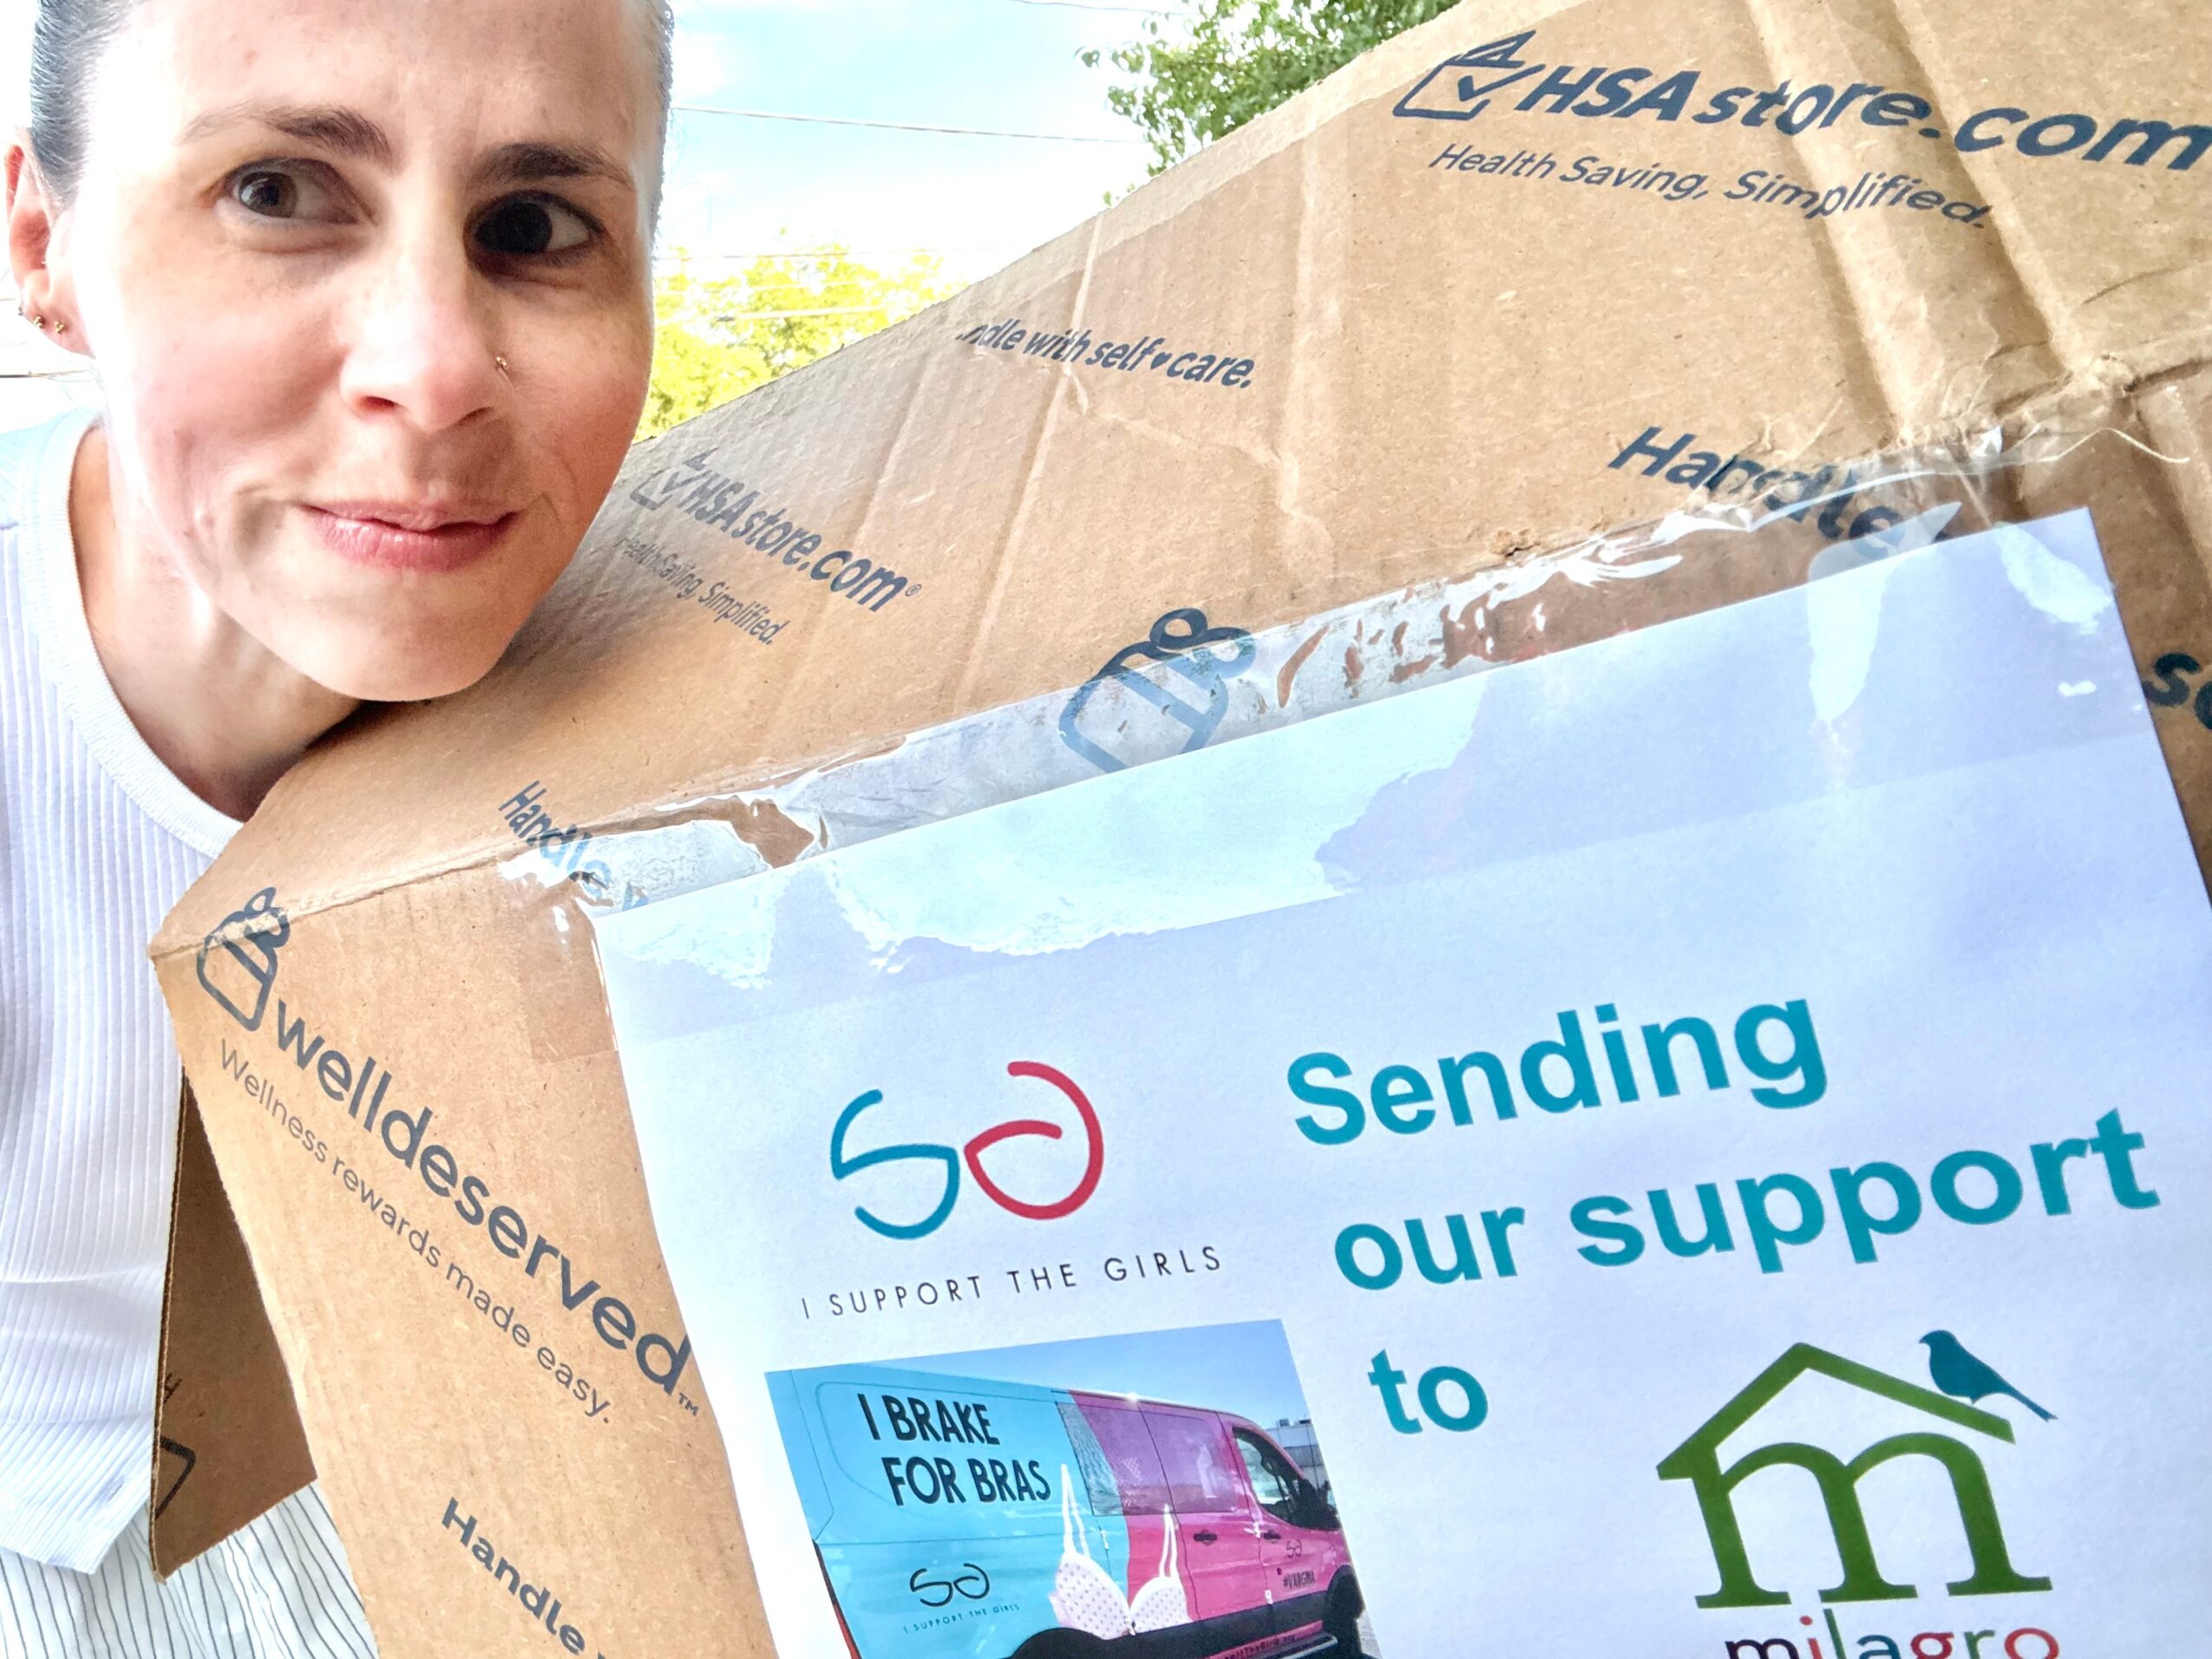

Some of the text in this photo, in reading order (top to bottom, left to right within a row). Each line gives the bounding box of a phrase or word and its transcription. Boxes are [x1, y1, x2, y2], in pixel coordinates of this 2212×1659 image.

[1429, 143, 1993, 230] Health Saving, Simplified.
[1022, 328, 1093, 362] with
[697, 581, 791, 645] Simplified.
[1286, 998, 1829, 1147] Sending
[221, 1038, 610, 1423] Wellness rewards made easy.
[1333, 1107, 2162, 1290] our support
[802, 1245, 1222, 1320] I SUPPORT THE GIRLS
[857, 1393, 1001, 1446] I BRAKE
[1366, 1348, 1489, 1435] to
[881, 1456, 1051, 1506] FOR BRAS
[441, 1496, 586, 1656] Handle
[913, 1612, 963, 1632] SUPPORT
[969, 1608, 988, 1618] THE
[992, 1603, 1021, 1614] GIRLS
